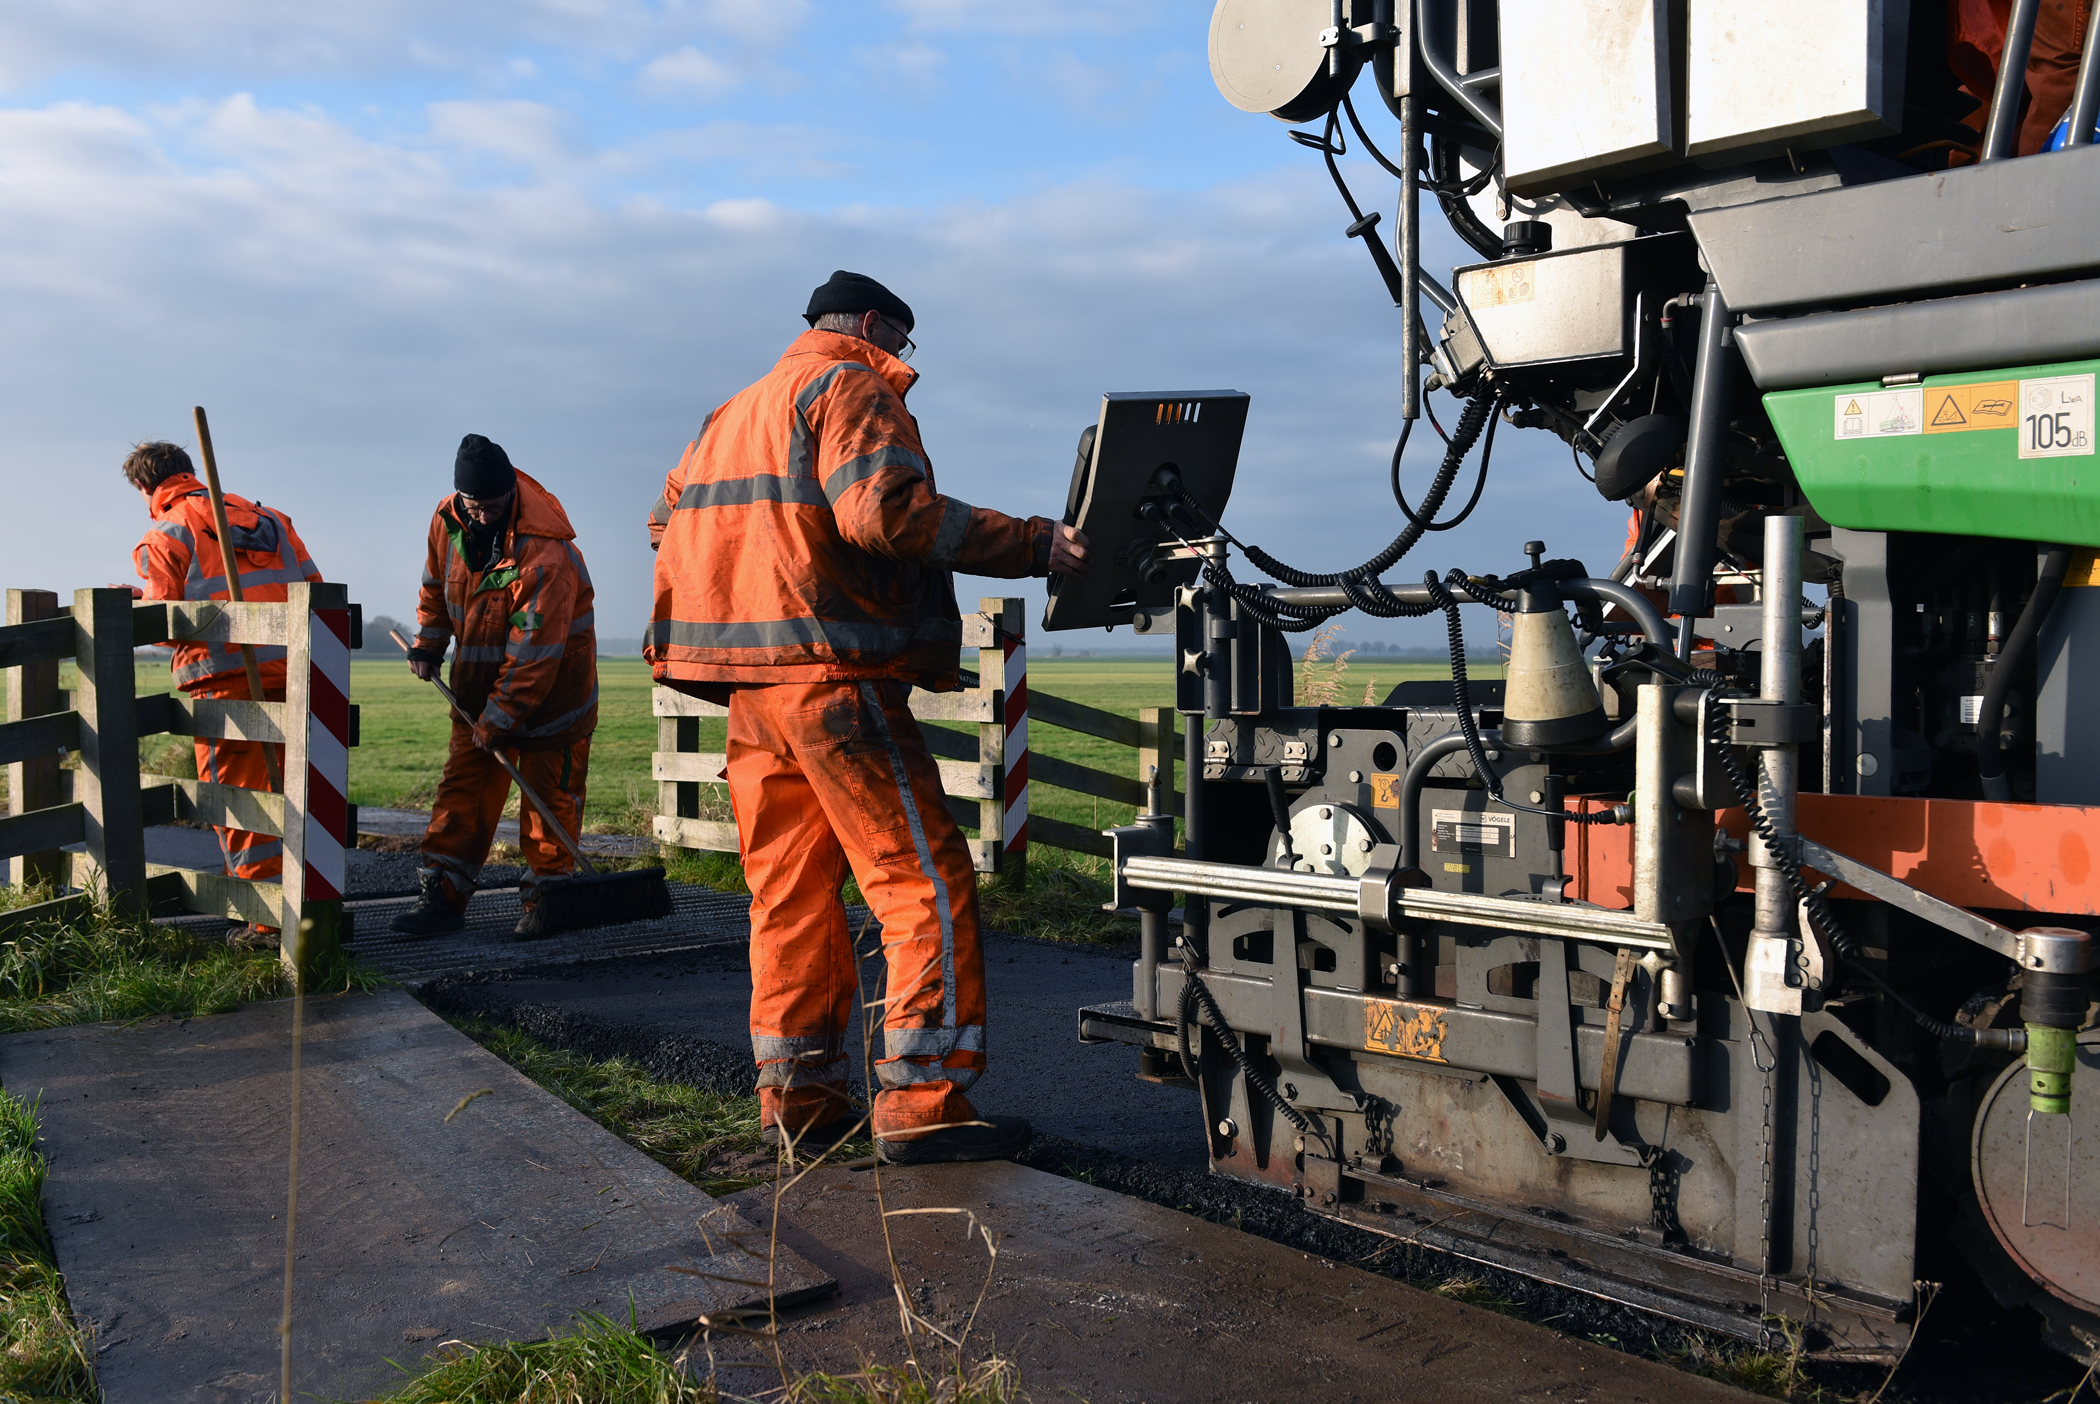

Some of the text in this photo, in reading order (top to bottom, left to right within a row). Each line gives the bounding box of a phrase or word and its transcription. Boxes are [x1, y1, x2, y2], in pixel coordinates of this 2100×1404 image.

[2026, 412, 2087, 450] 105 dB
[1488, 815, 1511, 823] VÖGELE
